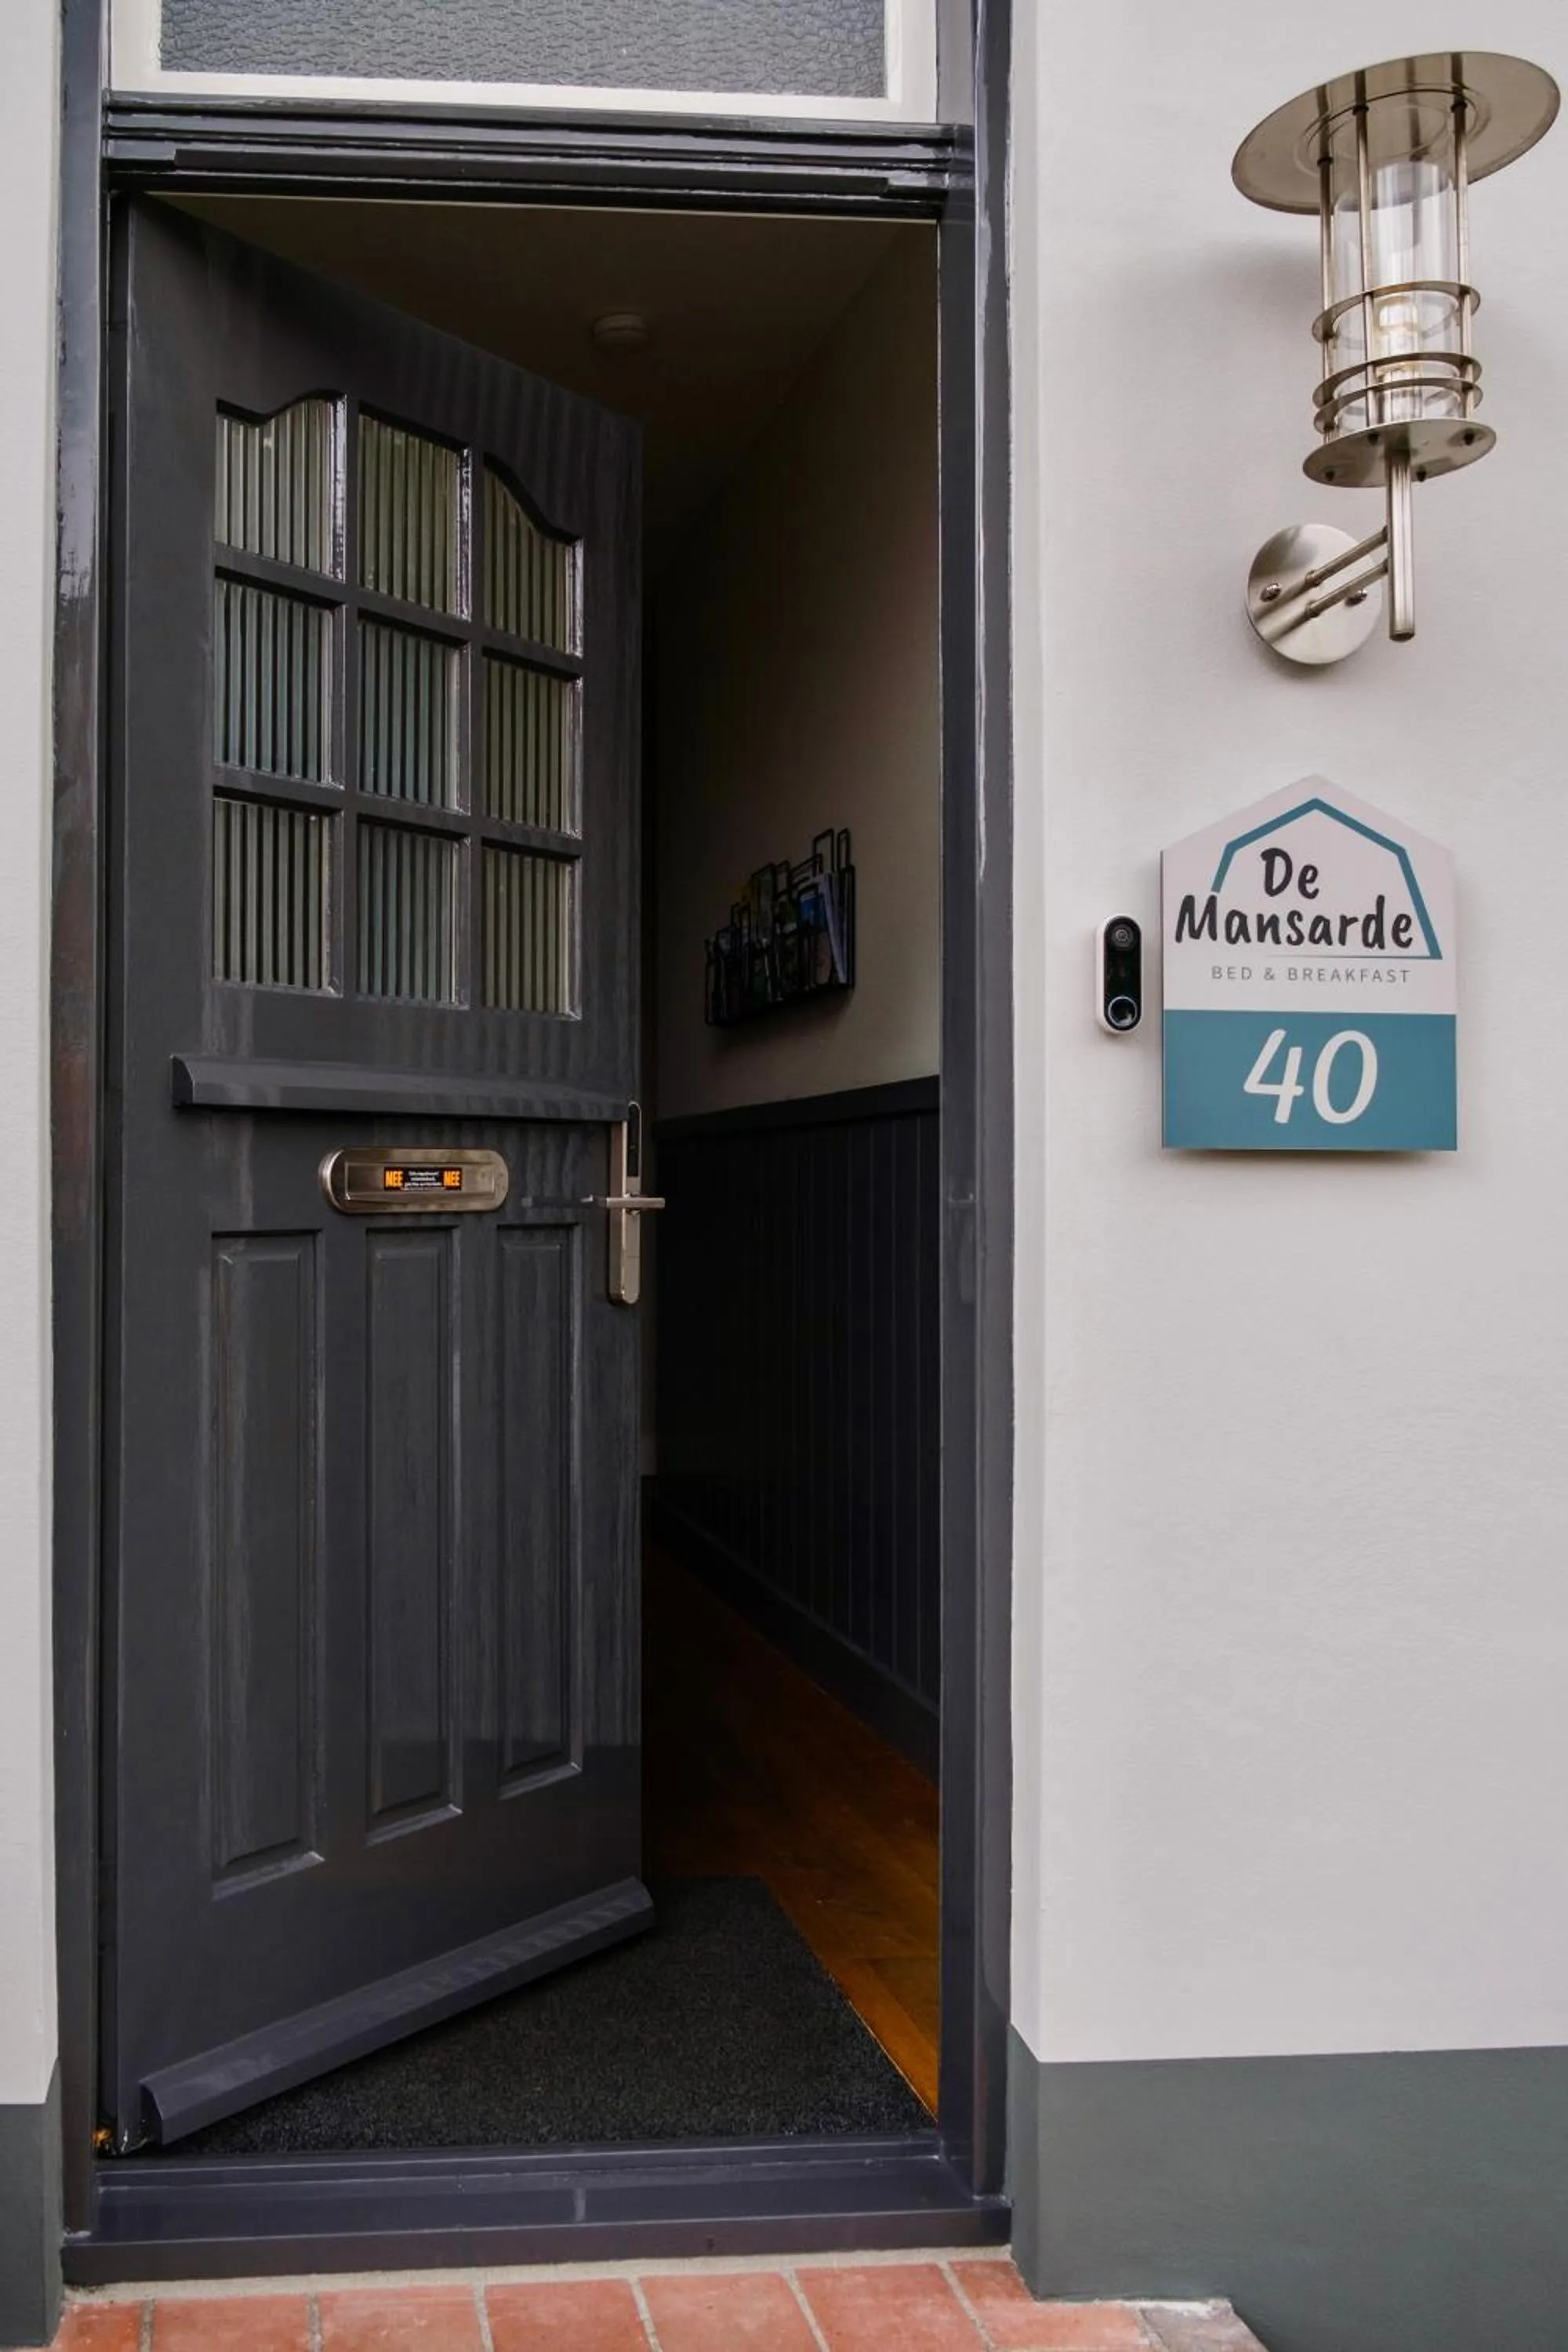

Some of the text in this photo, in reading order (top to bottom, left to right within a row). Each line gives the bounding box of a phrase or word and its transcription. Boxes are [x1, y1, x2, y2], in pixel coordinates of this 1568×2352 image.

[1260, 848, 1319, 900] De
[1175, 895, 1413, 950] Mansarde
[1211, 965, 1412, 984] BED & BREAKFAST
[1243, 1029, 1377, 1124] 40
[386, 1171, 403, 1186] NEE
[444, 1171, 460, 1186] NEE
